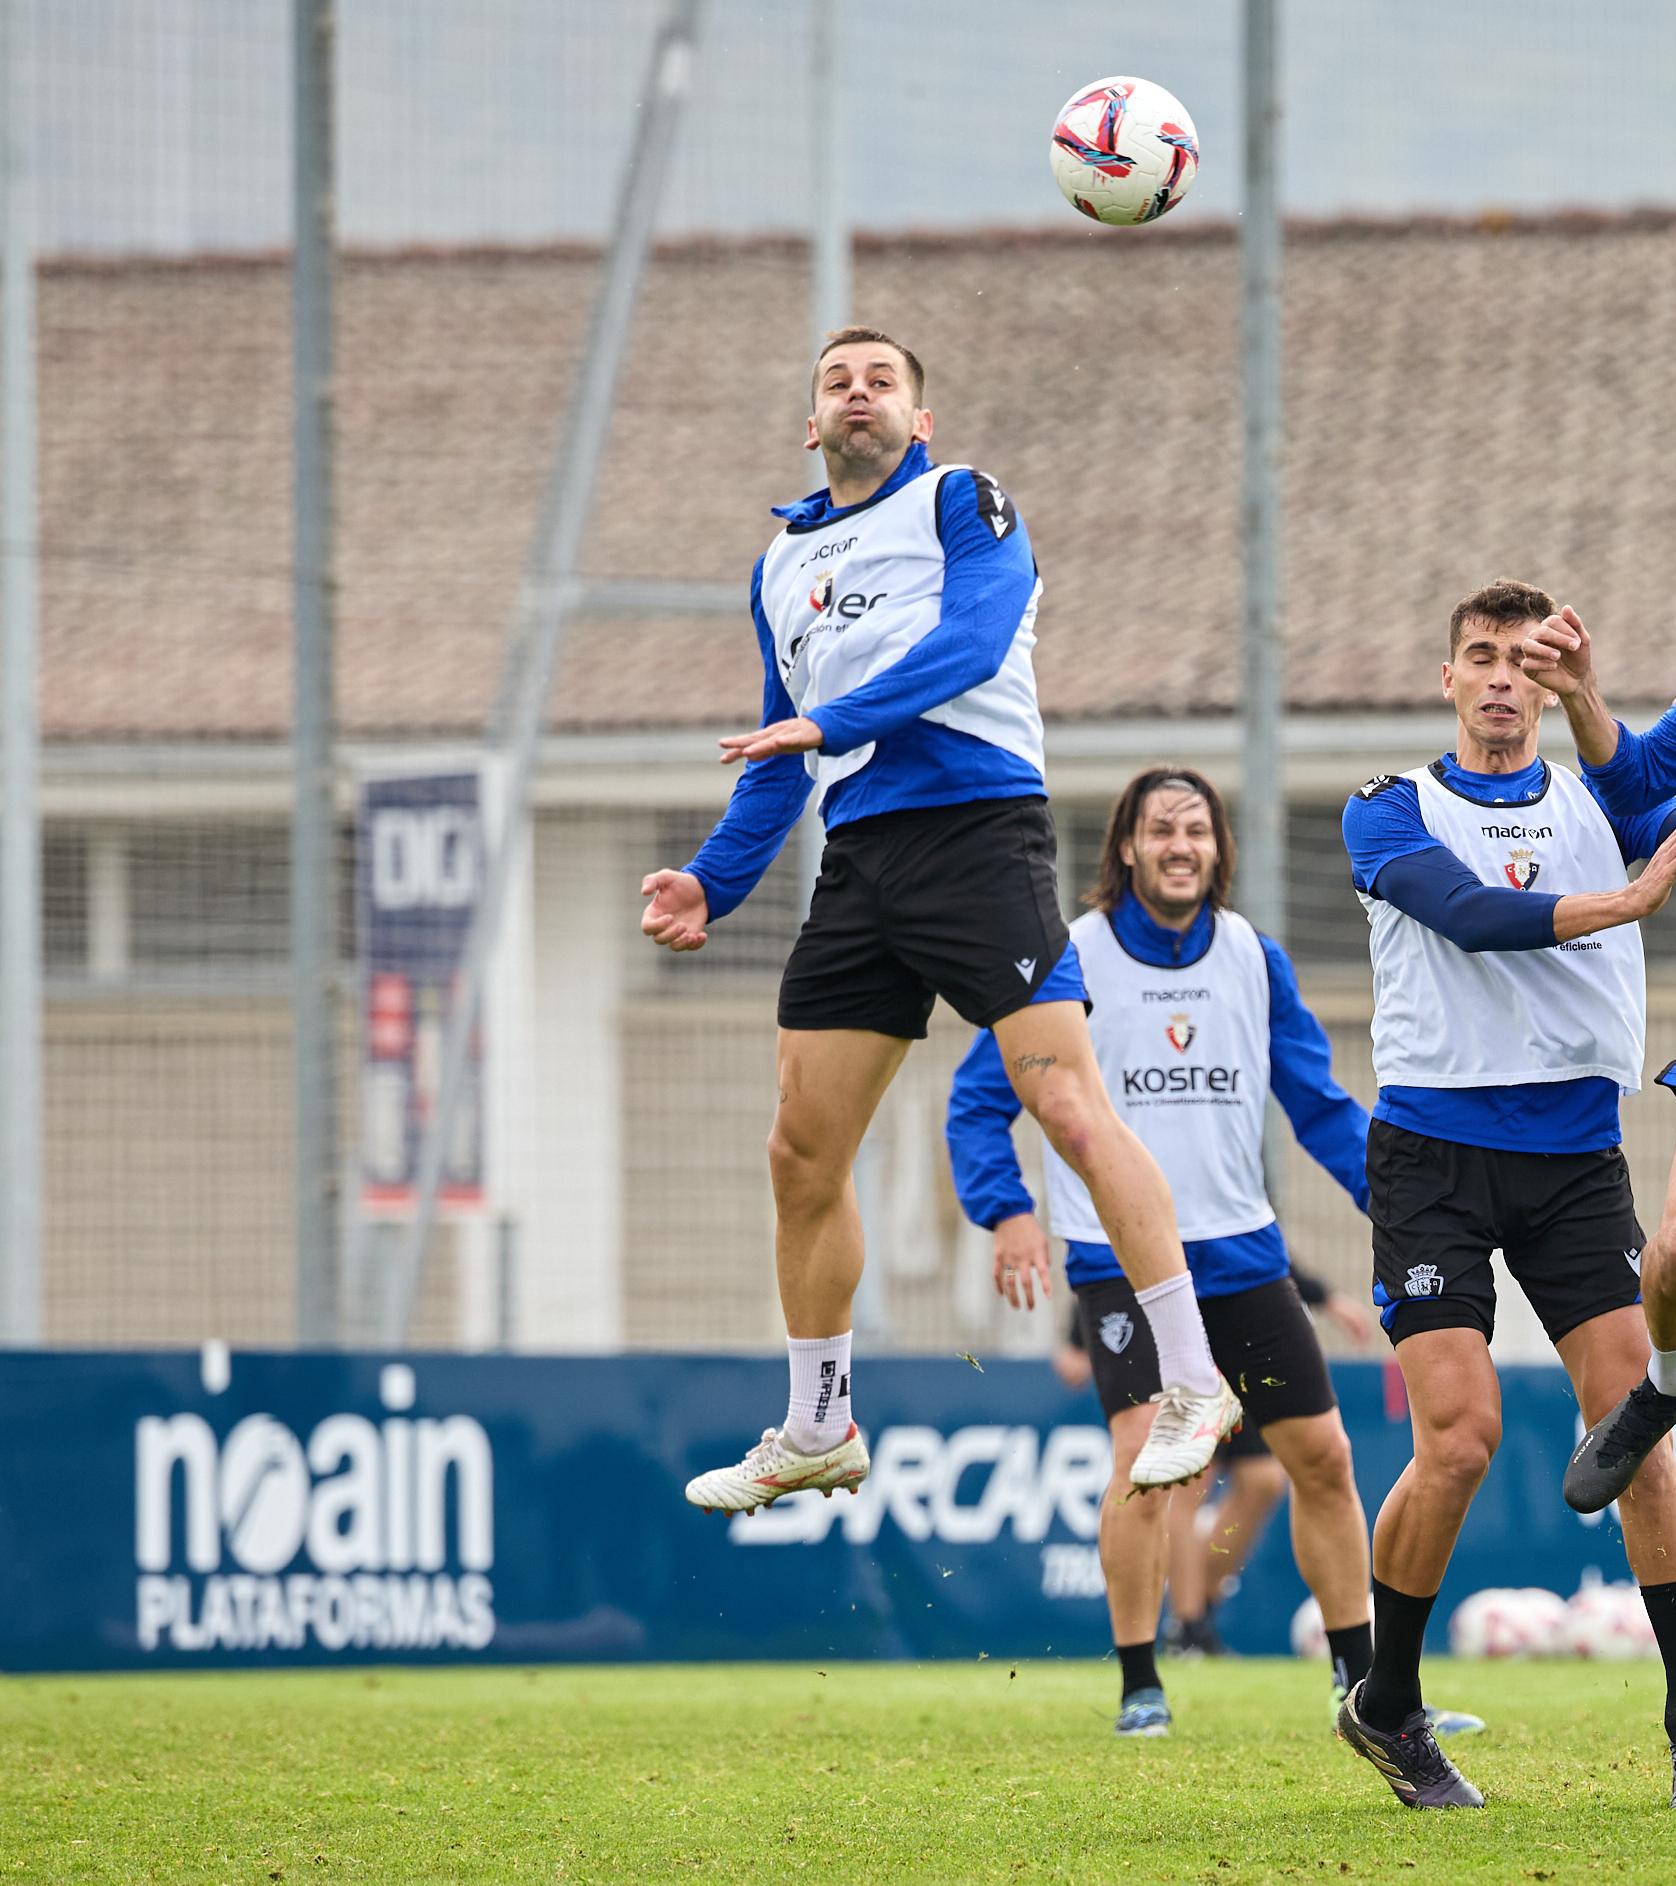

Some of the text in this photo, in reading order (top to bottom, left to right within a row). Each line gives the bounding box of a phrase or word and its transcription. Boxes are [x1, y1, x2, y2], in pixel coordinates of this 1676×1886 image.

[1481, 825, 1553, 839] macron
[1559, 940, 1602, 952] eficiente
[136, 1573, 496, 1652] PLATAFORMAS
